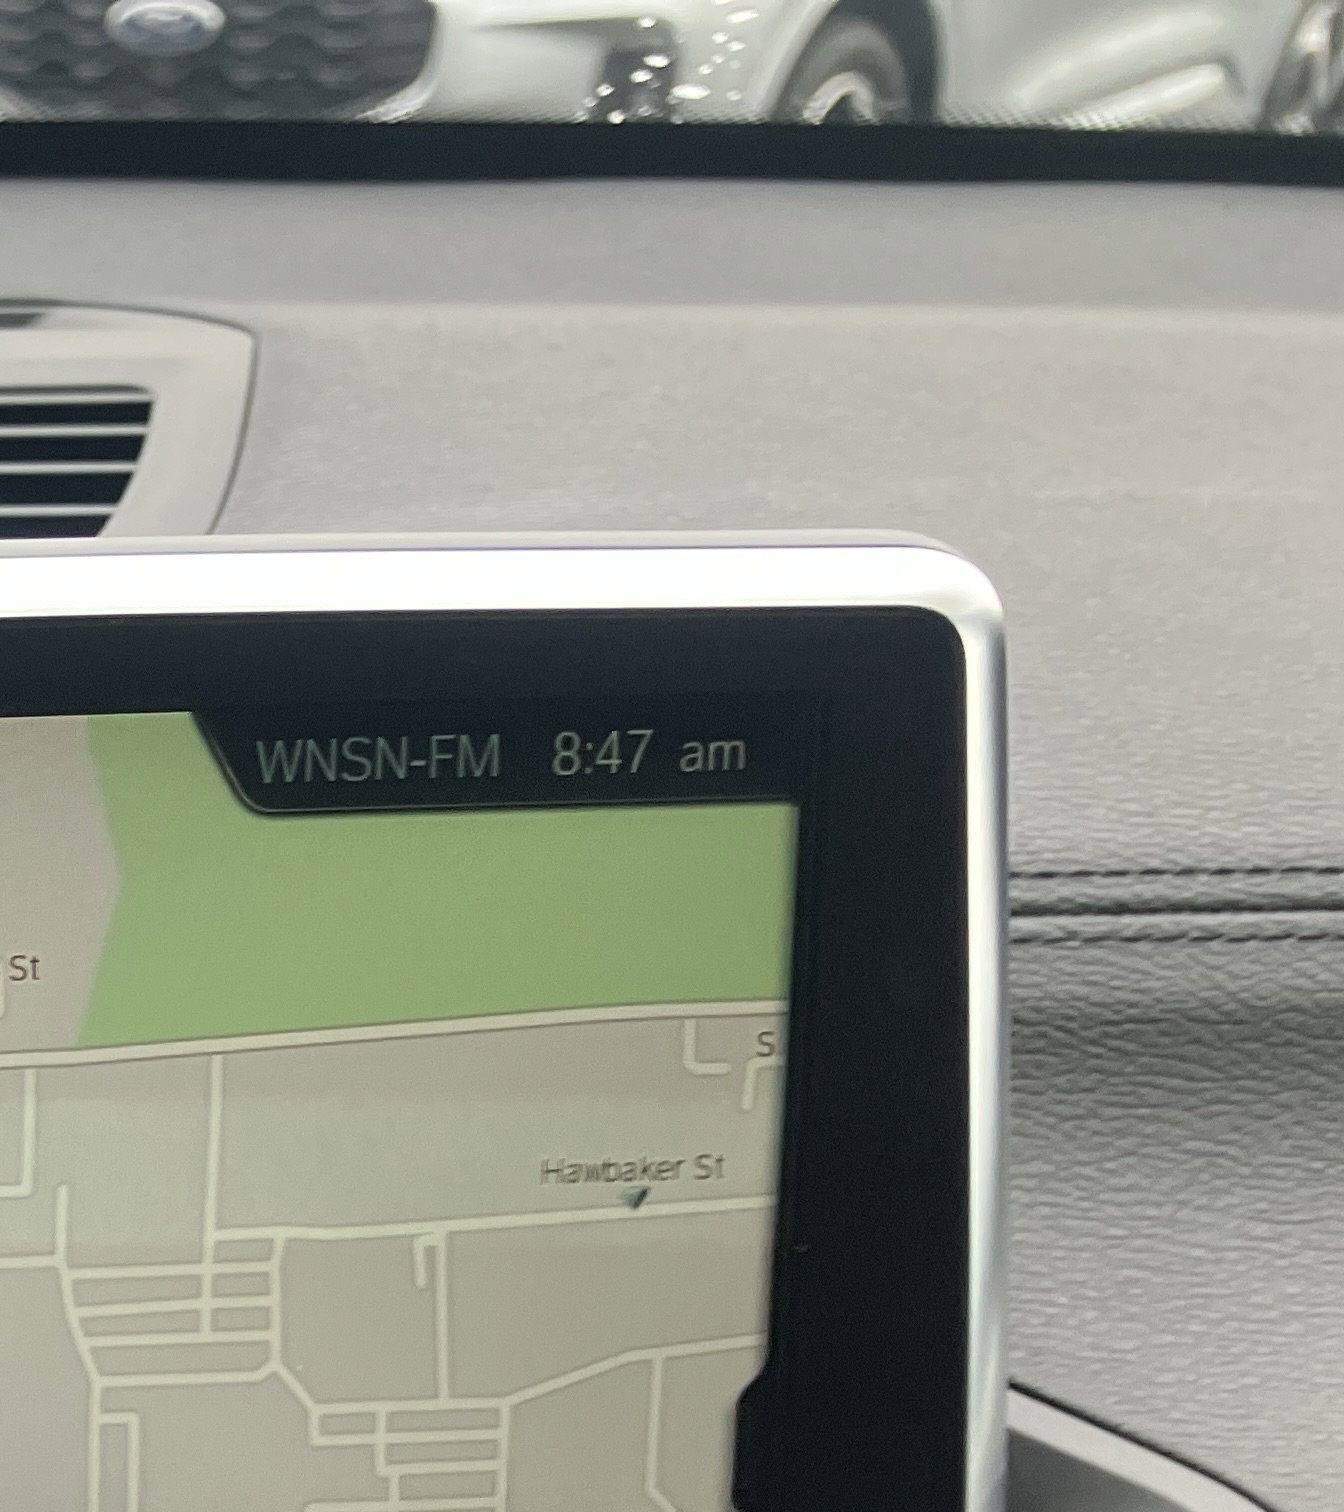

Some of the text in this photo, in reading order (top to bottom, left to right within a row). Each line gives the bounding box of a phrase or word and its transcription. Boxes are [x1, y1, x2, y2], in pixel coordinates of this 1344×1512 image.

[255, 733, 502, 784] WNSN-FM
[551, 728, 748, 777] 8:47 am
[8, 954, 41, 982] St
[693, 1153, 726, 1180] St
